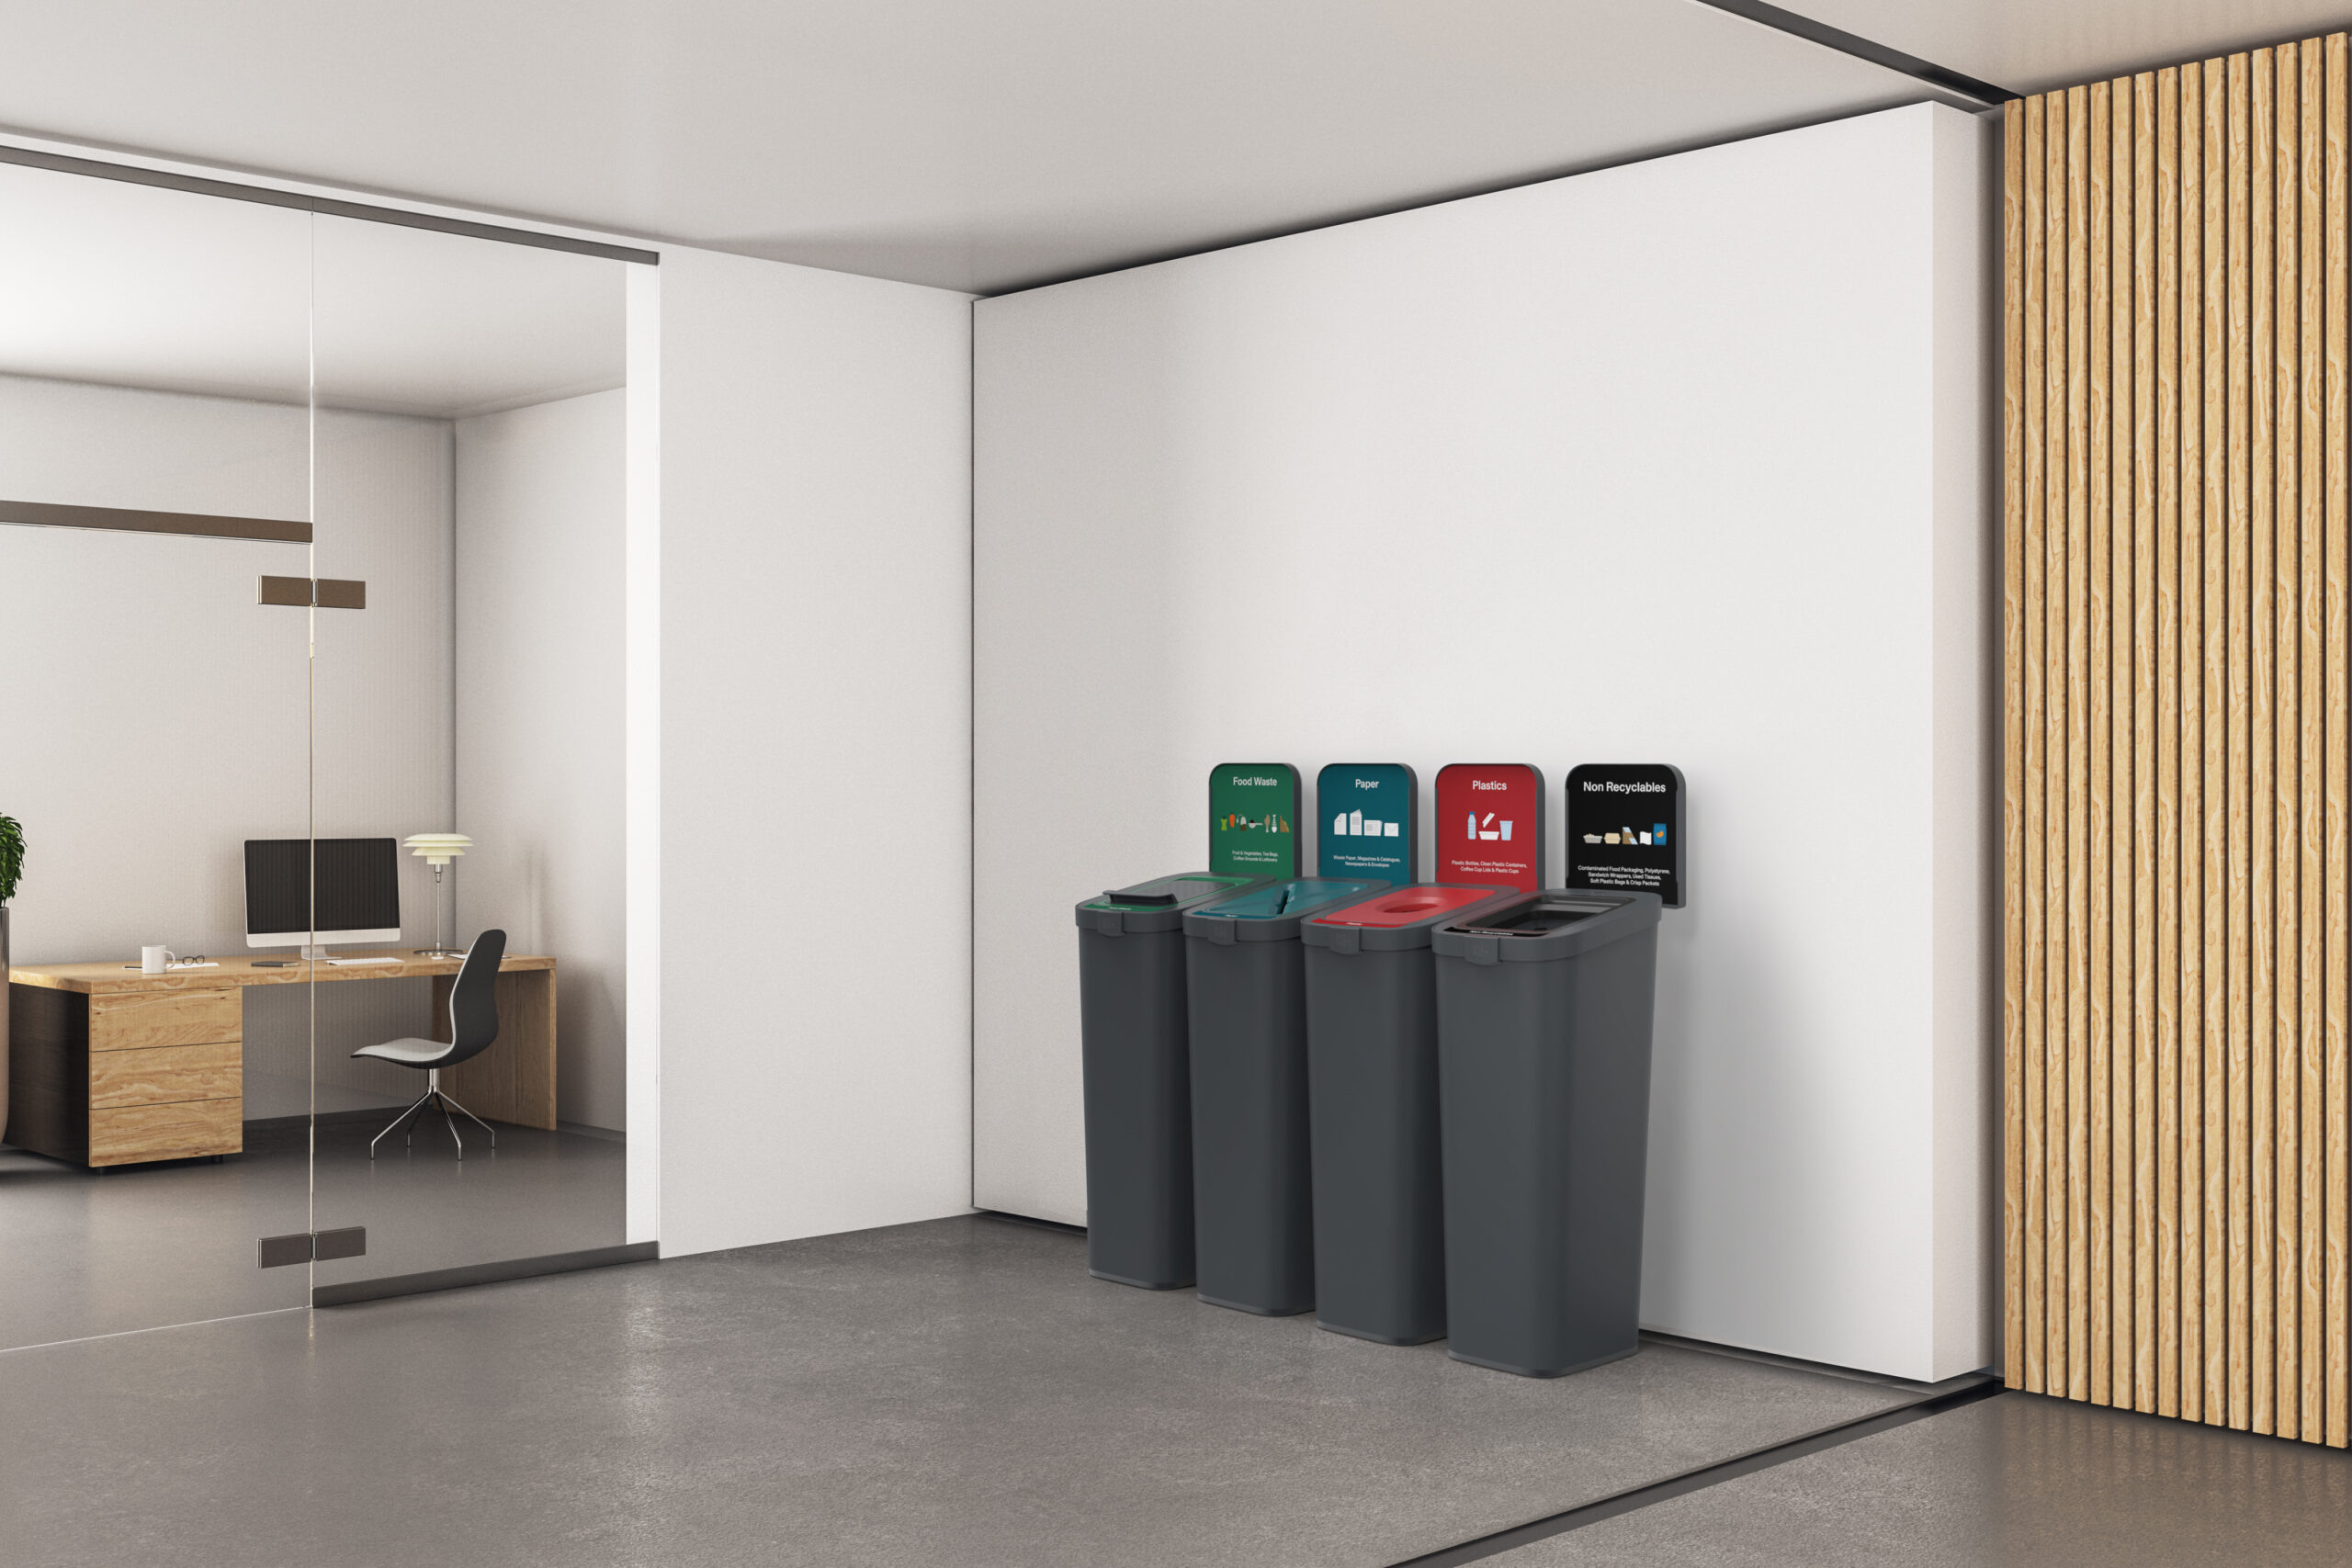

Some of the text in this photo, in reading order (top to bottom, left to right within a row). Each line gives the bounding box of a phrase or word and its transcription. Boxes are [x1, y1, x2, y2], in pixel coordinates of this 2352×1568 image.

[1233, 776, 1278, 786] Food Waste
[1355, 778, 1380, 791] Paper
[1472, 780, 1508, 791] Plastics
[1583, 781, 1667, 795] Non Recyclables
